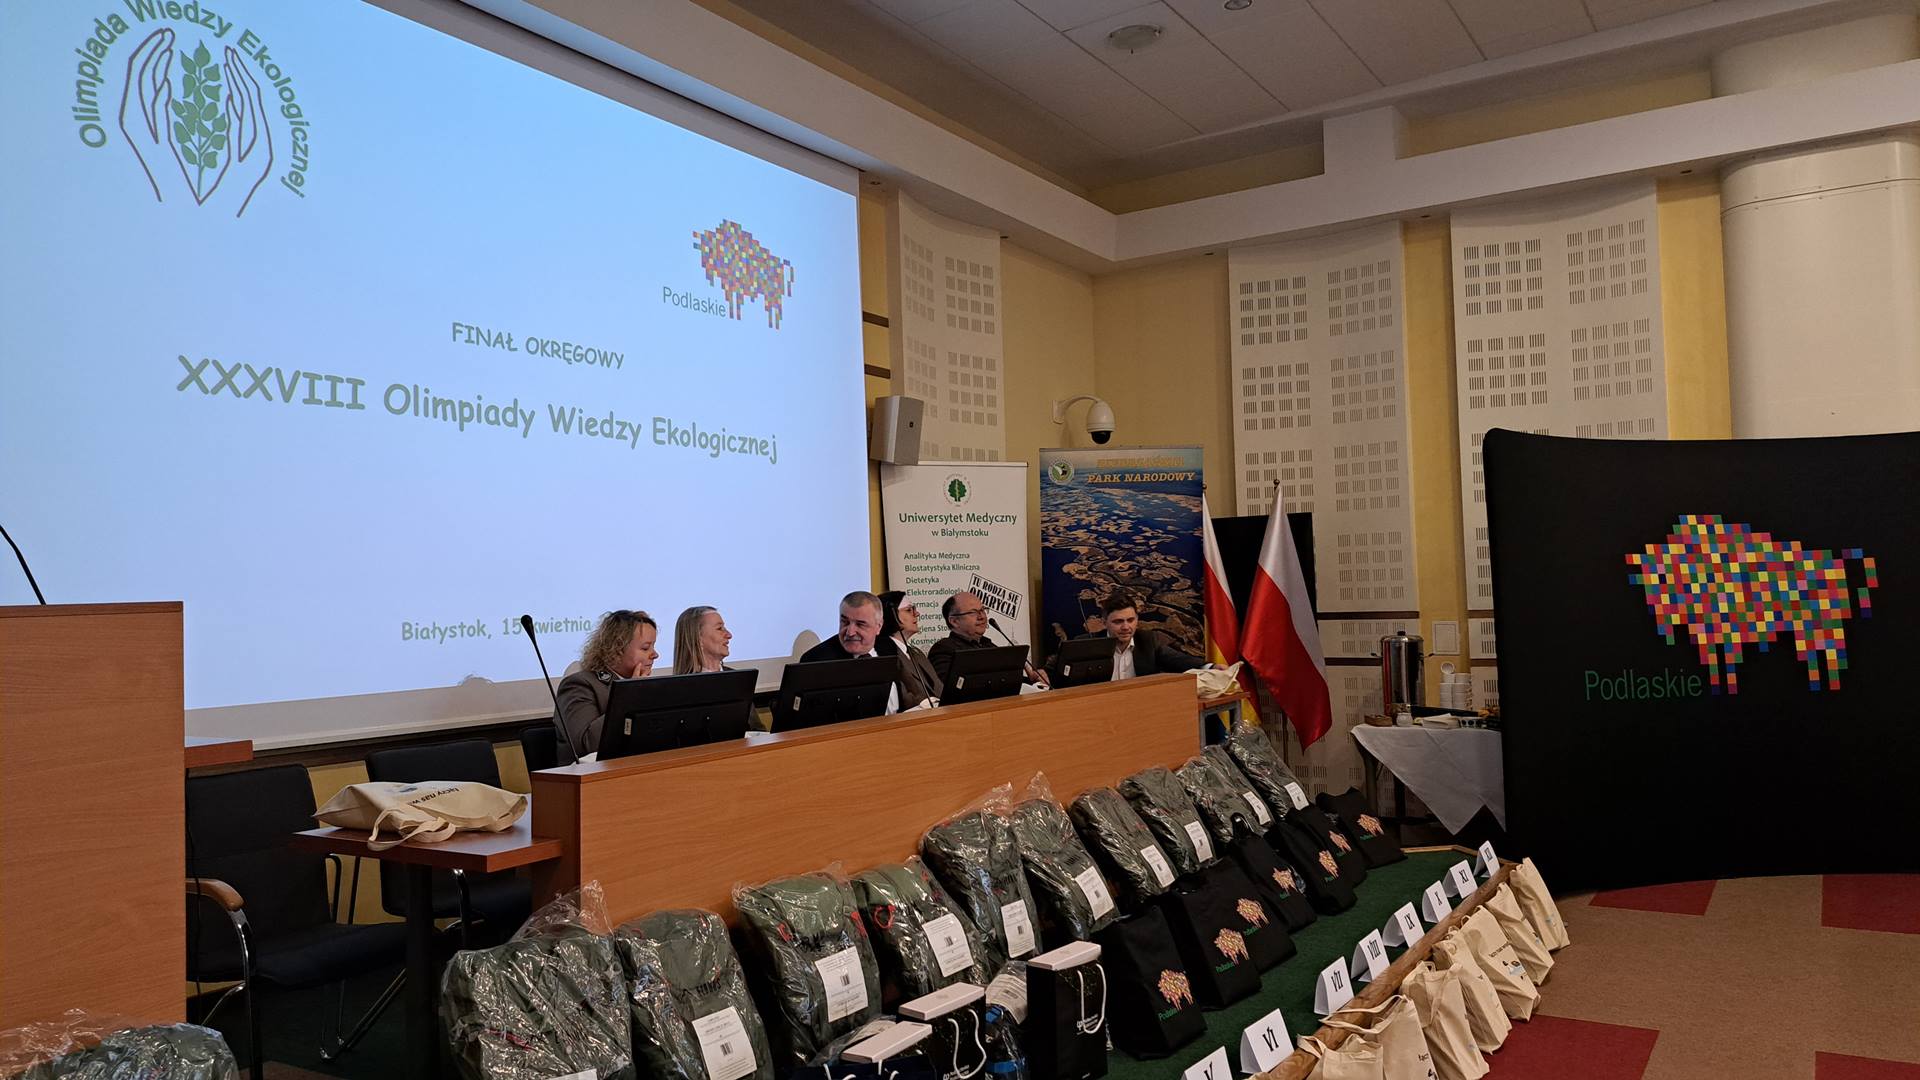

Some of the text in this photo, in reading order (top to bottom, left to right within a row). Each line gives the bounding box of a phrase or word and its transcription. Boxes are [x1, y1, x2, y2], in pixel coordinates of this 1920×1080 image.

[71, 0, 312, 199] Olimpiada Wiedzy Ekologicznej
[662, 285, 727, 318] Podlaskie
[452, 321, 624, 370] FINAŁ OKRĘGOWY
[176, 354, 778, 465] XXXVIII Olimpiady Wiedzy Ekologicznej
[1087, 471, 1196, 484] PARK NARODOWY
[899, 512, 1018, 526] Uniwersytet Medyczny
[941, 528, 989, 538] Białymstoku
[903, 552, 970, 561] Analityka Medyczna
[904, 563, 981, 573] Biostatystyka Kliniczna
[905, 576, 940, 585] Dietetyka
[906, 587, 963, 596] Elektroradiologi
[912, 601, 939, 609] armacja
[401, 618, 492, 644] Białystok,
[1584, 666, 1703, 701] Podlaskie
[1458, 869, 1469, 884] XI
[1434, 890, 1443, 906] X
[1330, 969, 1344, 992] VII
[1262, 1026, 1280, 1052] VI
